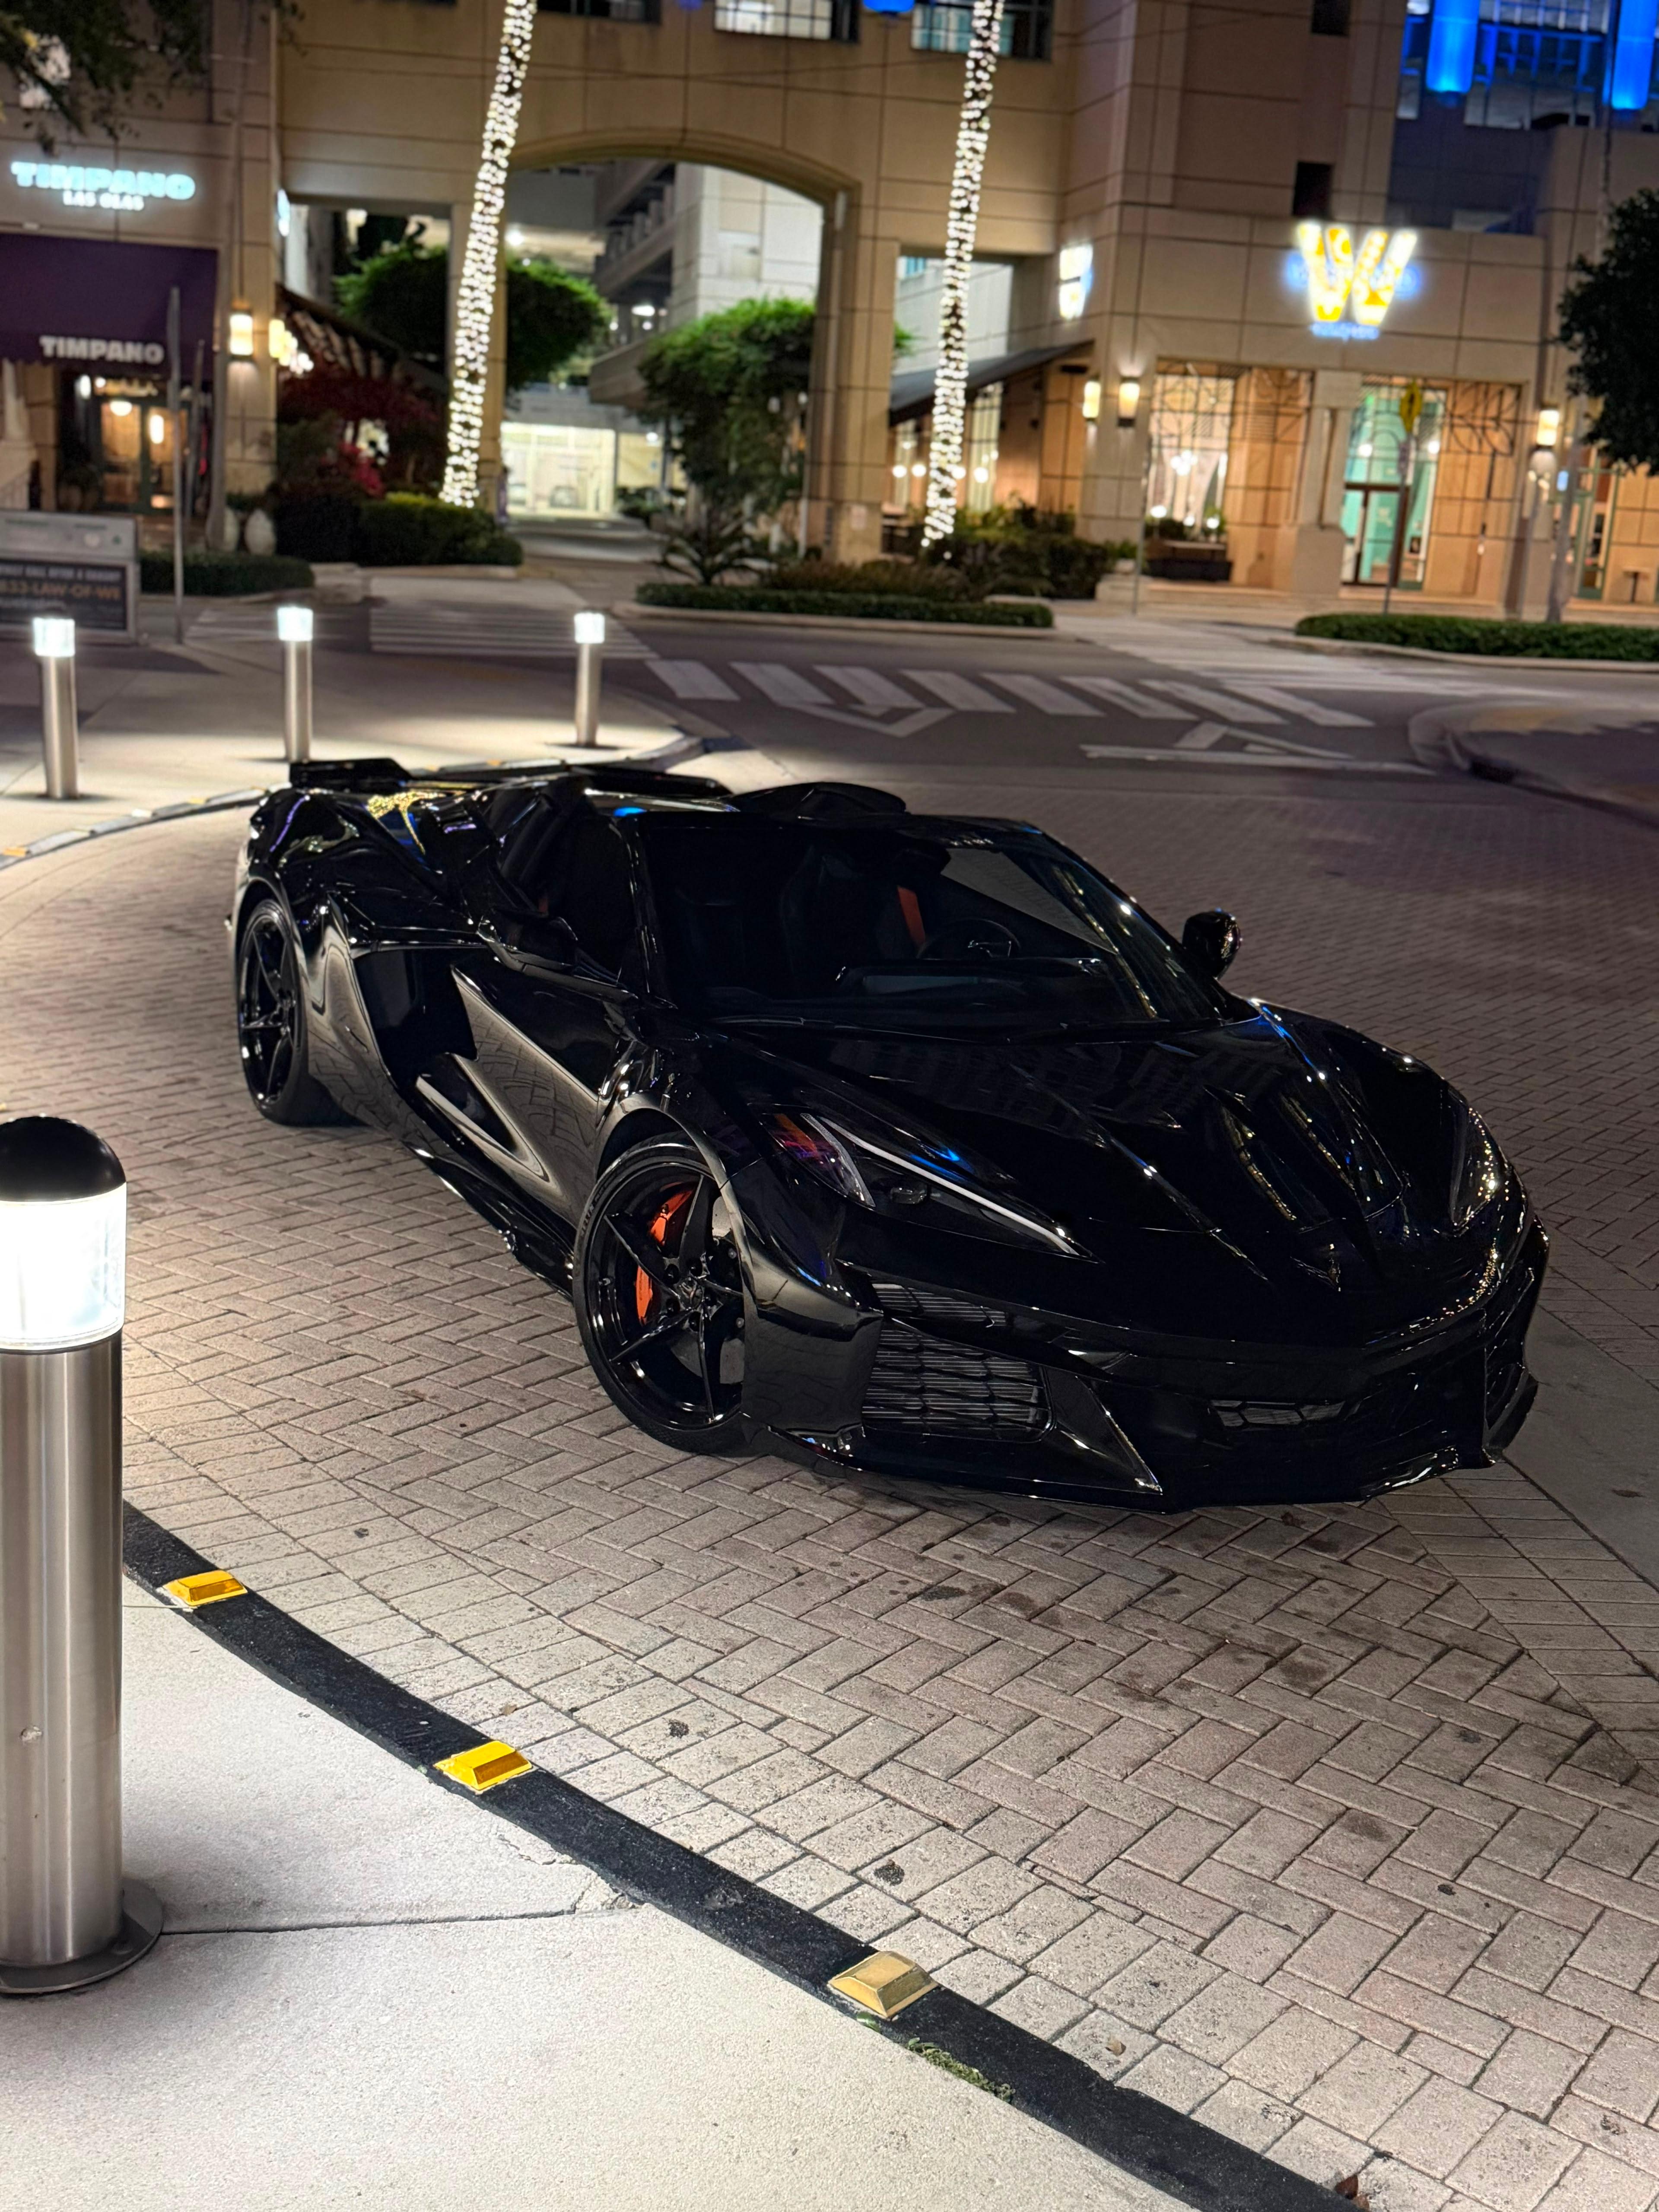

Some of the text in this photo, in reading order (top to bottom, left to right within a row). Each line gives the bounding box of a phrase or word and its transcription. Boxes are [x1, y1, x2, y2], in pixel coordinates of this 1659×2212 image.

[11, 162, 195, 200] TIMPANO
[63, 190, 96, 207] LAS
[39, 335, 165, 364] TIMPANO
